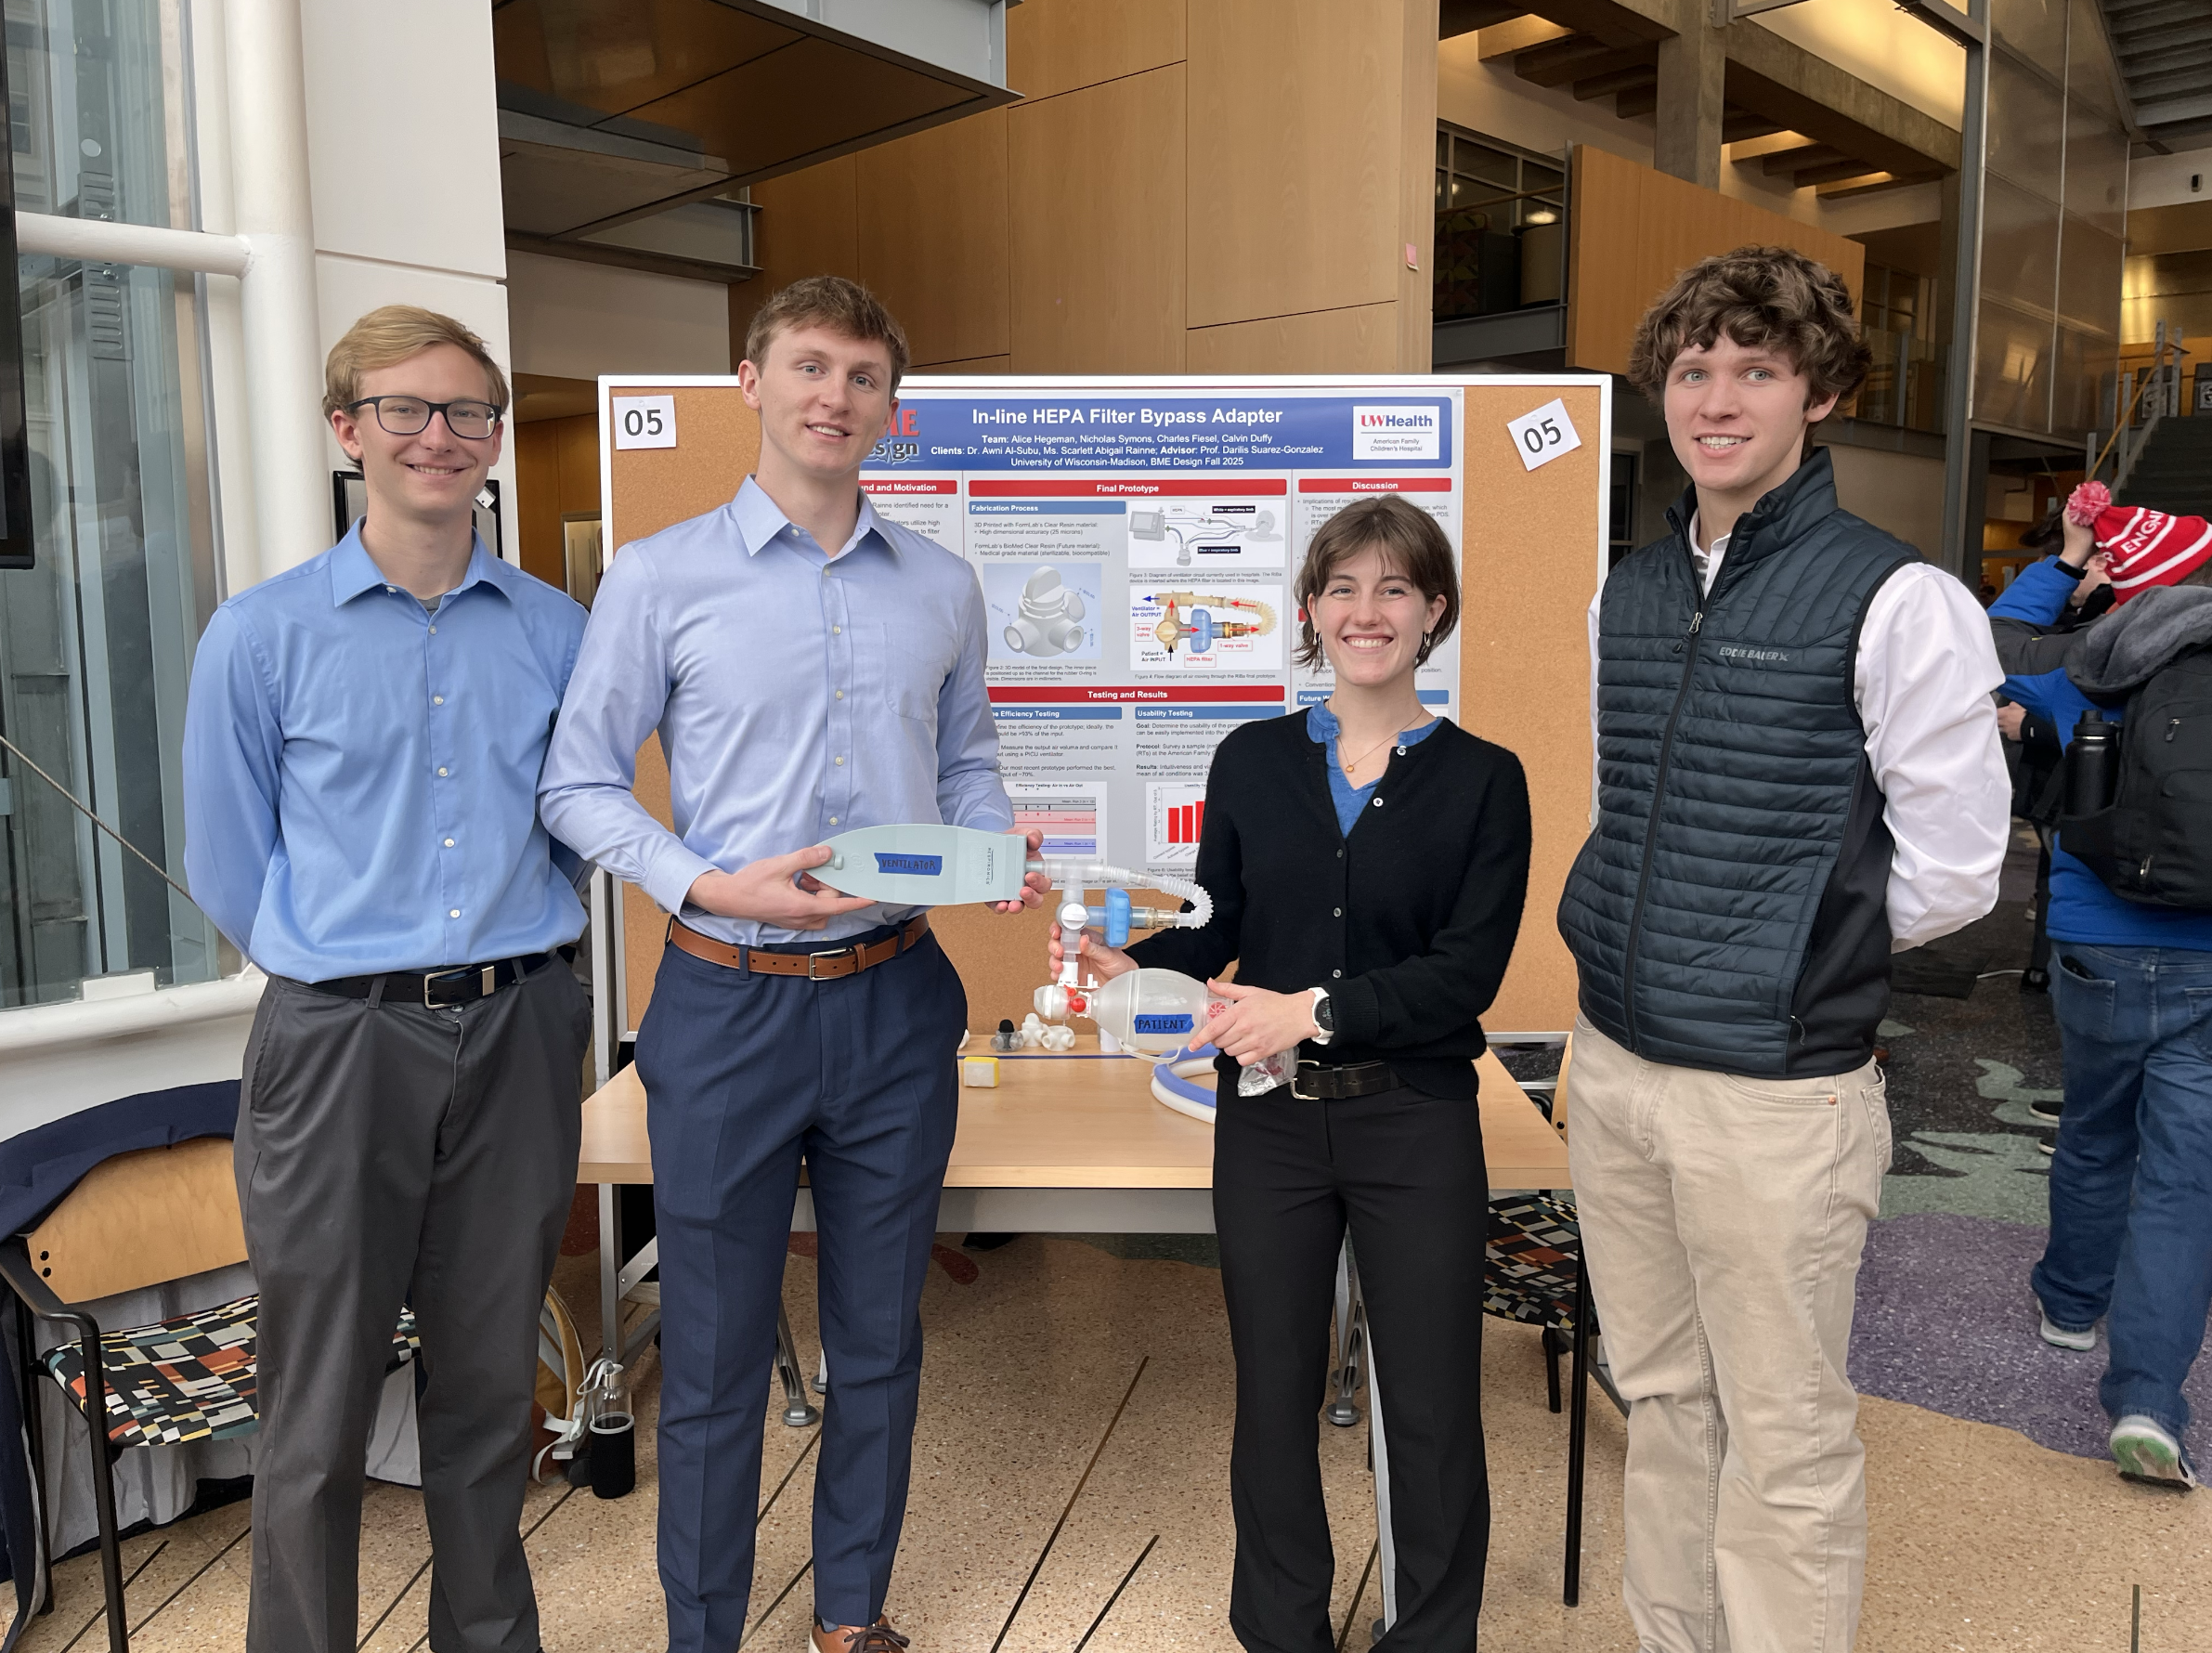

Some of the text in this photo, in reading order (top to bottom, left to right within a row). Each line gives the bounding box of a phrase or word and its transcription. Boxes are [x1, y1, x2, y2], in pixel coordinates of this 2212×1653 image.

[625, 409, 663, 436] 05
[972, 408, 1283, 427] In-line HEPA Filter Bypass Adapter
[1034, 436, 1078, 445] Hegeman,
[1118, 435, 1155, 445] Symons,
[1191, 435, 1220, 444] Fiesel,
[1250, 435, 1273, 445] Duffy
[1524, 418, 1561, 453] 05
[874, 439, 918, 459] sign
[1004, 446, 1041, 456] Al-Subu,
[1094, 446, 1123, 456] Abigail
[1125, 446, 1158, 455] Rainne;
[1010, 458, 1052, 468] University
[1064, 458, 1149, 467] Wisconsin-Madison,
[1173, 458, 1203, 468] Design
[1119, 485, 1159, 494] Prototype
[1087, 691, 1118, 700] Testing
[882, 859, 936, 870] VENTILATOR
[1139, 1019, 1185, 1030] PATIENT
